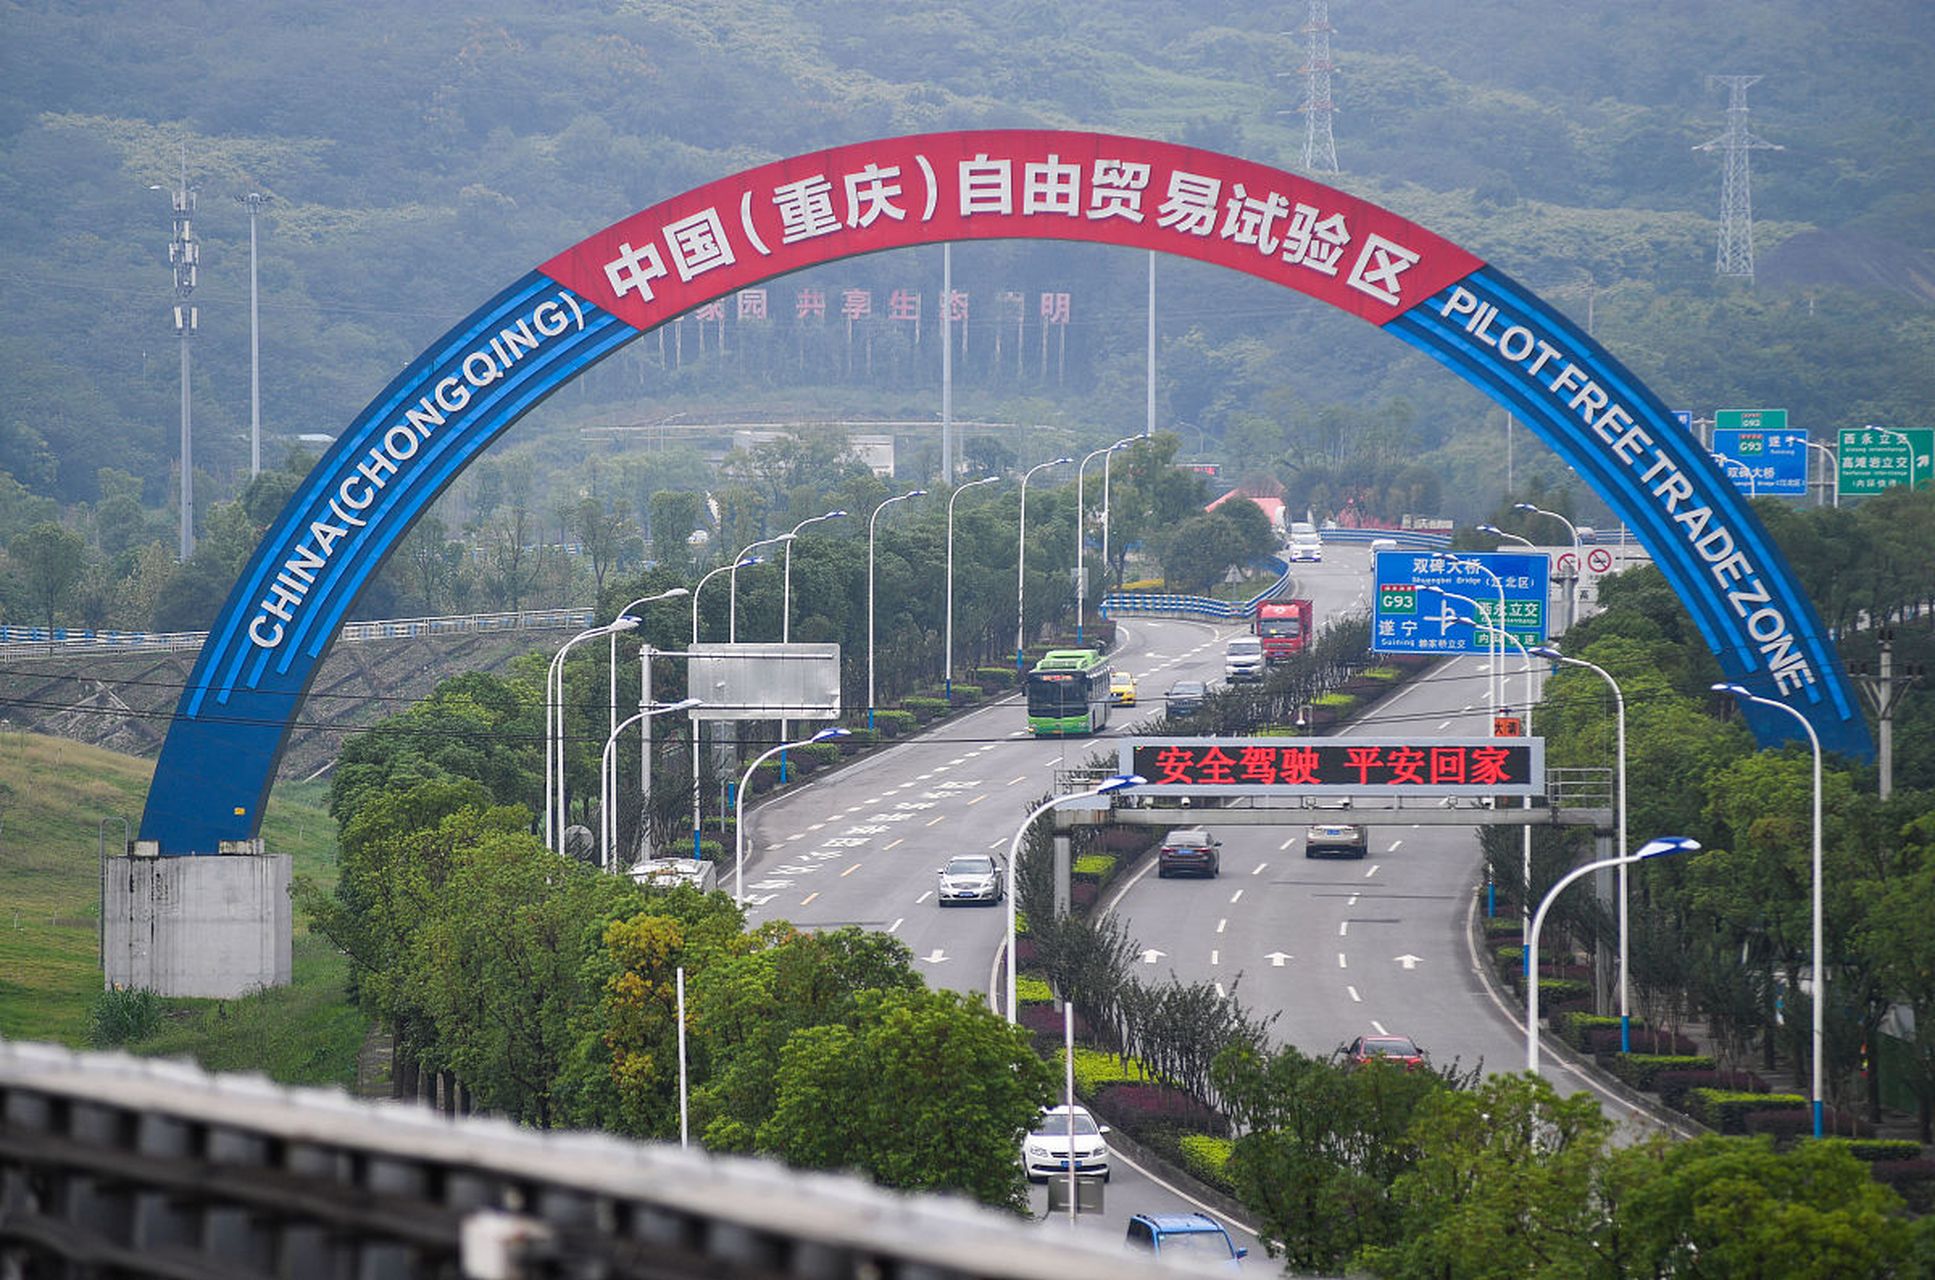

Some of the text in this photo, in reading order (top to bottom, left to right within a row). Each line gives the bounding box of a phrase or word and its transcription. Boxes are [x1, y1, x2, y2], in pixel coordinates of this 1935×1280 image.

[603, 154, 1421, 307] 中国（重庆）自由贸易试验区
[673, 288, 1071, 324] 家园 共享生态明
[1739, 442, 1763, 451] G93
[1440, 286, 1816, 697] PILOT FREE TRADE ZONE
[1413, 558, 1481, 573] 双碑大桥
[1383, 595, 1413, 608] G93
[1378, 619, 1418, 637] 遂宁
[1155, 746, 1510, 785] 安全驾驶 平安回家
